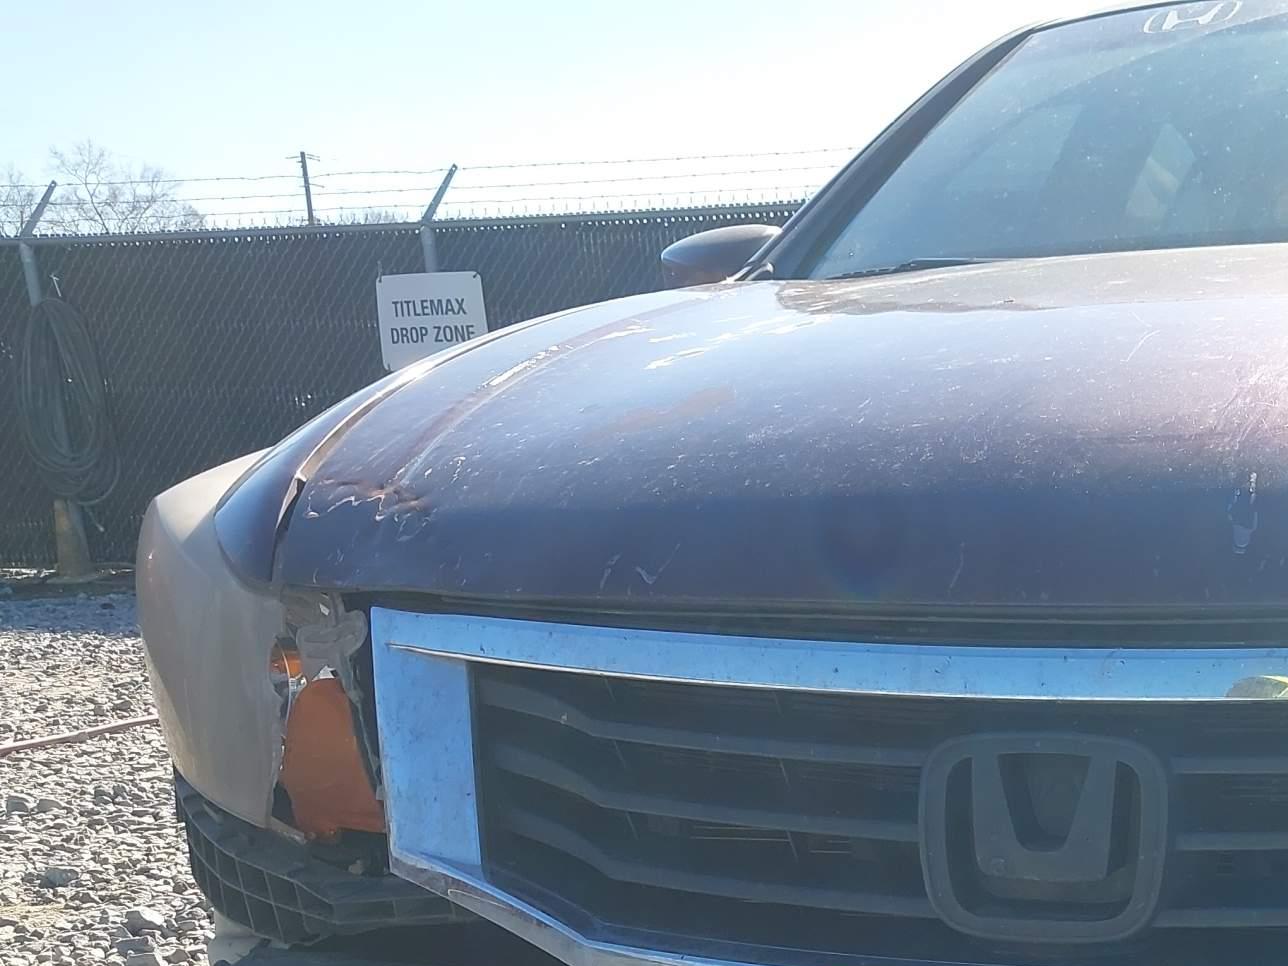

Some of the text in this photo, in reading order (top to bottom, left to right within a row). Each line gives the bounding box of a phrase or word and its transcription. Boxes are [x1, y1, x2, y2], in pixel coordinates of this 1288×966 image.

[391, 297, 467, 318] TITLEMAX
[390, 324, 476, 345] DROP ZONE
